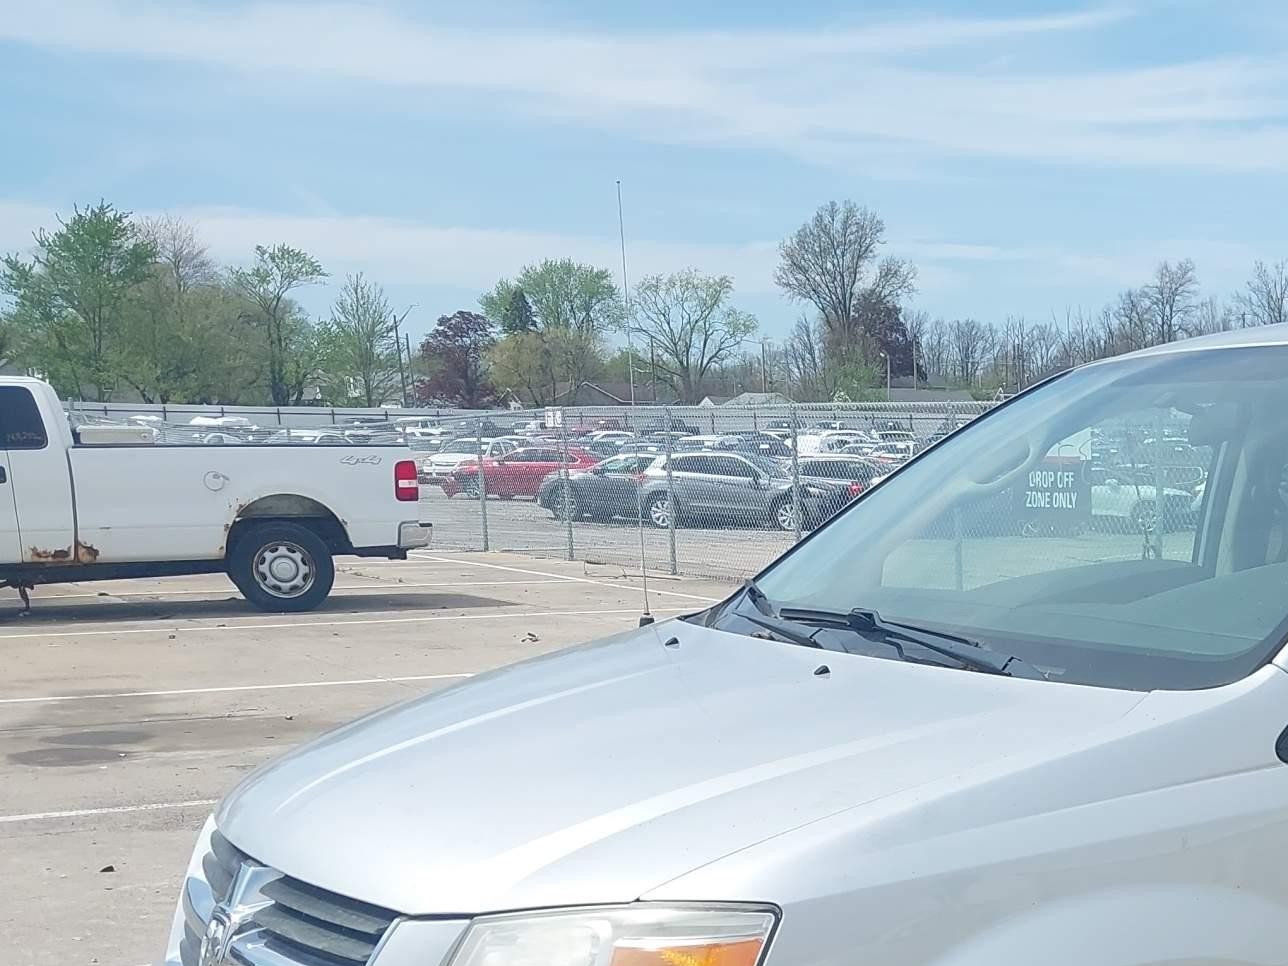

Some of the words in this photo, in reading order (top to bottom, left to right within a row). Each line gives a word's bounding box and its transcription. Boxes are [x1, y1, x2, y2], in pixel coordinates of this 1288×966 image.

[1028, 471, 1055, 488] DROP
[1057, 471, 1075, 488] OFF
[1025, 491, 1051, 508] ZONE
[1052, 491, 1078, 509] ONLY
